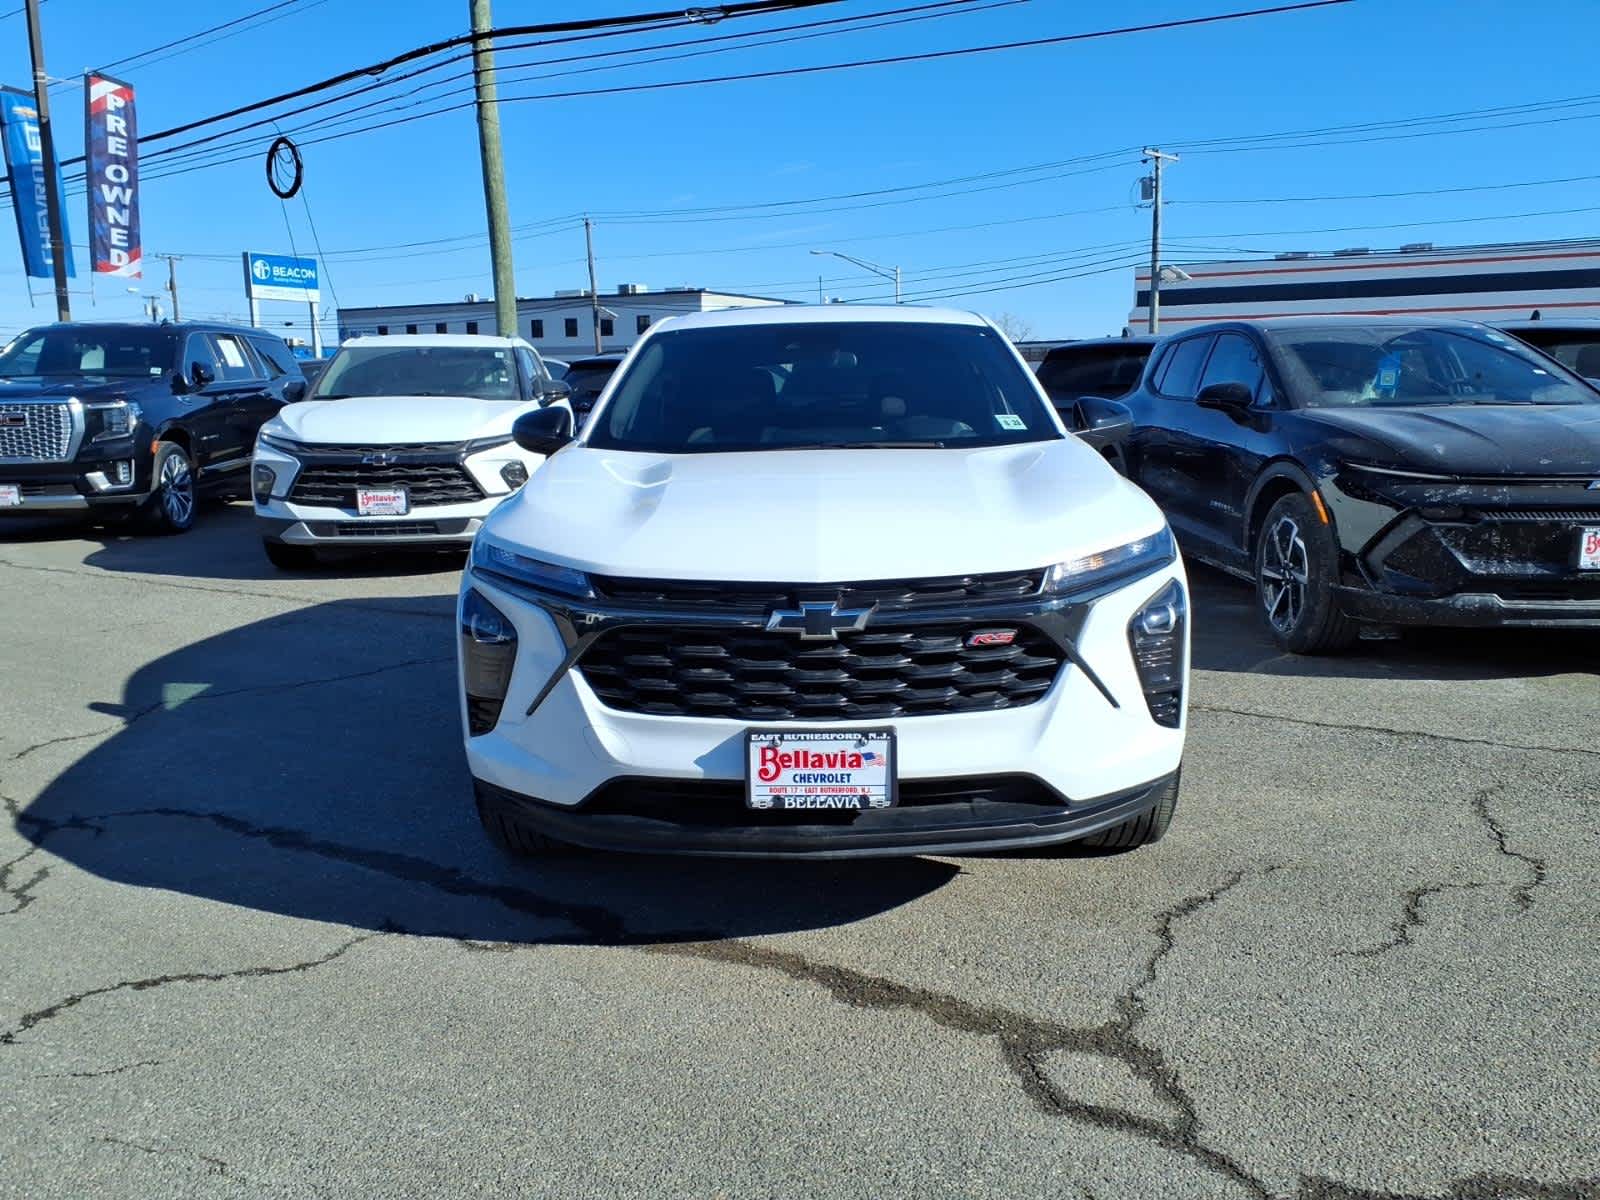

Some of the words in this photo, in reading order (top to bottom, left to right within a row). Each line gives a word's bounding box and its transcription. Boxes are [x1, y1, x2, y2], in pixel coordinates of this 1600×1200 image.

[106, 93, 128, 157] PRE
[101, 163, 133, 267] OWNED
[272, 266, 316, 279] BEACON
[970, 631, 1016, 646] RS
[758, 746, 863, 782] Bellavia
[792, 773, 852, 784] CHEVROLET
[769, 786, 788, 794] ROUTE
[804, 786, 818, 794] EAST
[784, 796, 861, 809] BELLAVIA
